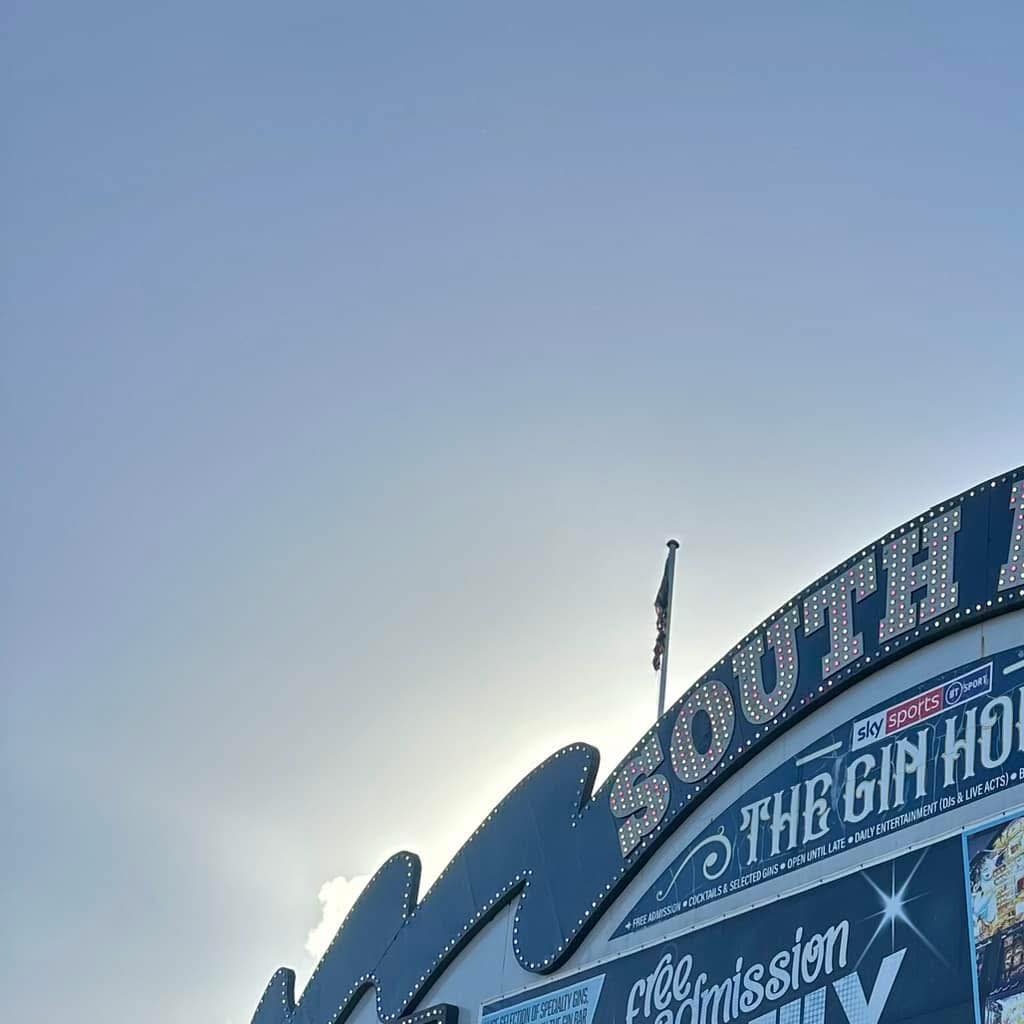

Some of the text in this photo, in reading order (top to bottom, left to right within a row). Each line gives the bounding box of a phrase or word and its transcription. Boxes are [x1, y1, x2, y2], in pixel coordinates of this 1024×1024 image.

[610, 504, 962, 858] SOUTH
[857, 718, 884, 742] sky
[887, 694, 940, 728] sports
[963, 675, 988, 692] SPORT
[632, 913, 647, 929] FREE
[648, 902, 681, 922] ADMISSION
[688, 886, 722, 907] COCKTAILS
[730, 873, 761, 891] SELECTED
[762, 864, 779, 878] GINS
[787, 853, 806, 869] OPEN
[807, 846, 826, 861] UNTIL
[828, 838, 846, 853] LATE
[855, 827, 875, 843] DAILY
[876, 801, 938, 834] ENTERTAINMENT
[965, 784, 983, 800] LIVE
[984, 773, 1009, 792] ACTS)
[739, 772, 834, 866] THE
[844, 726, 931, 824] GIN
